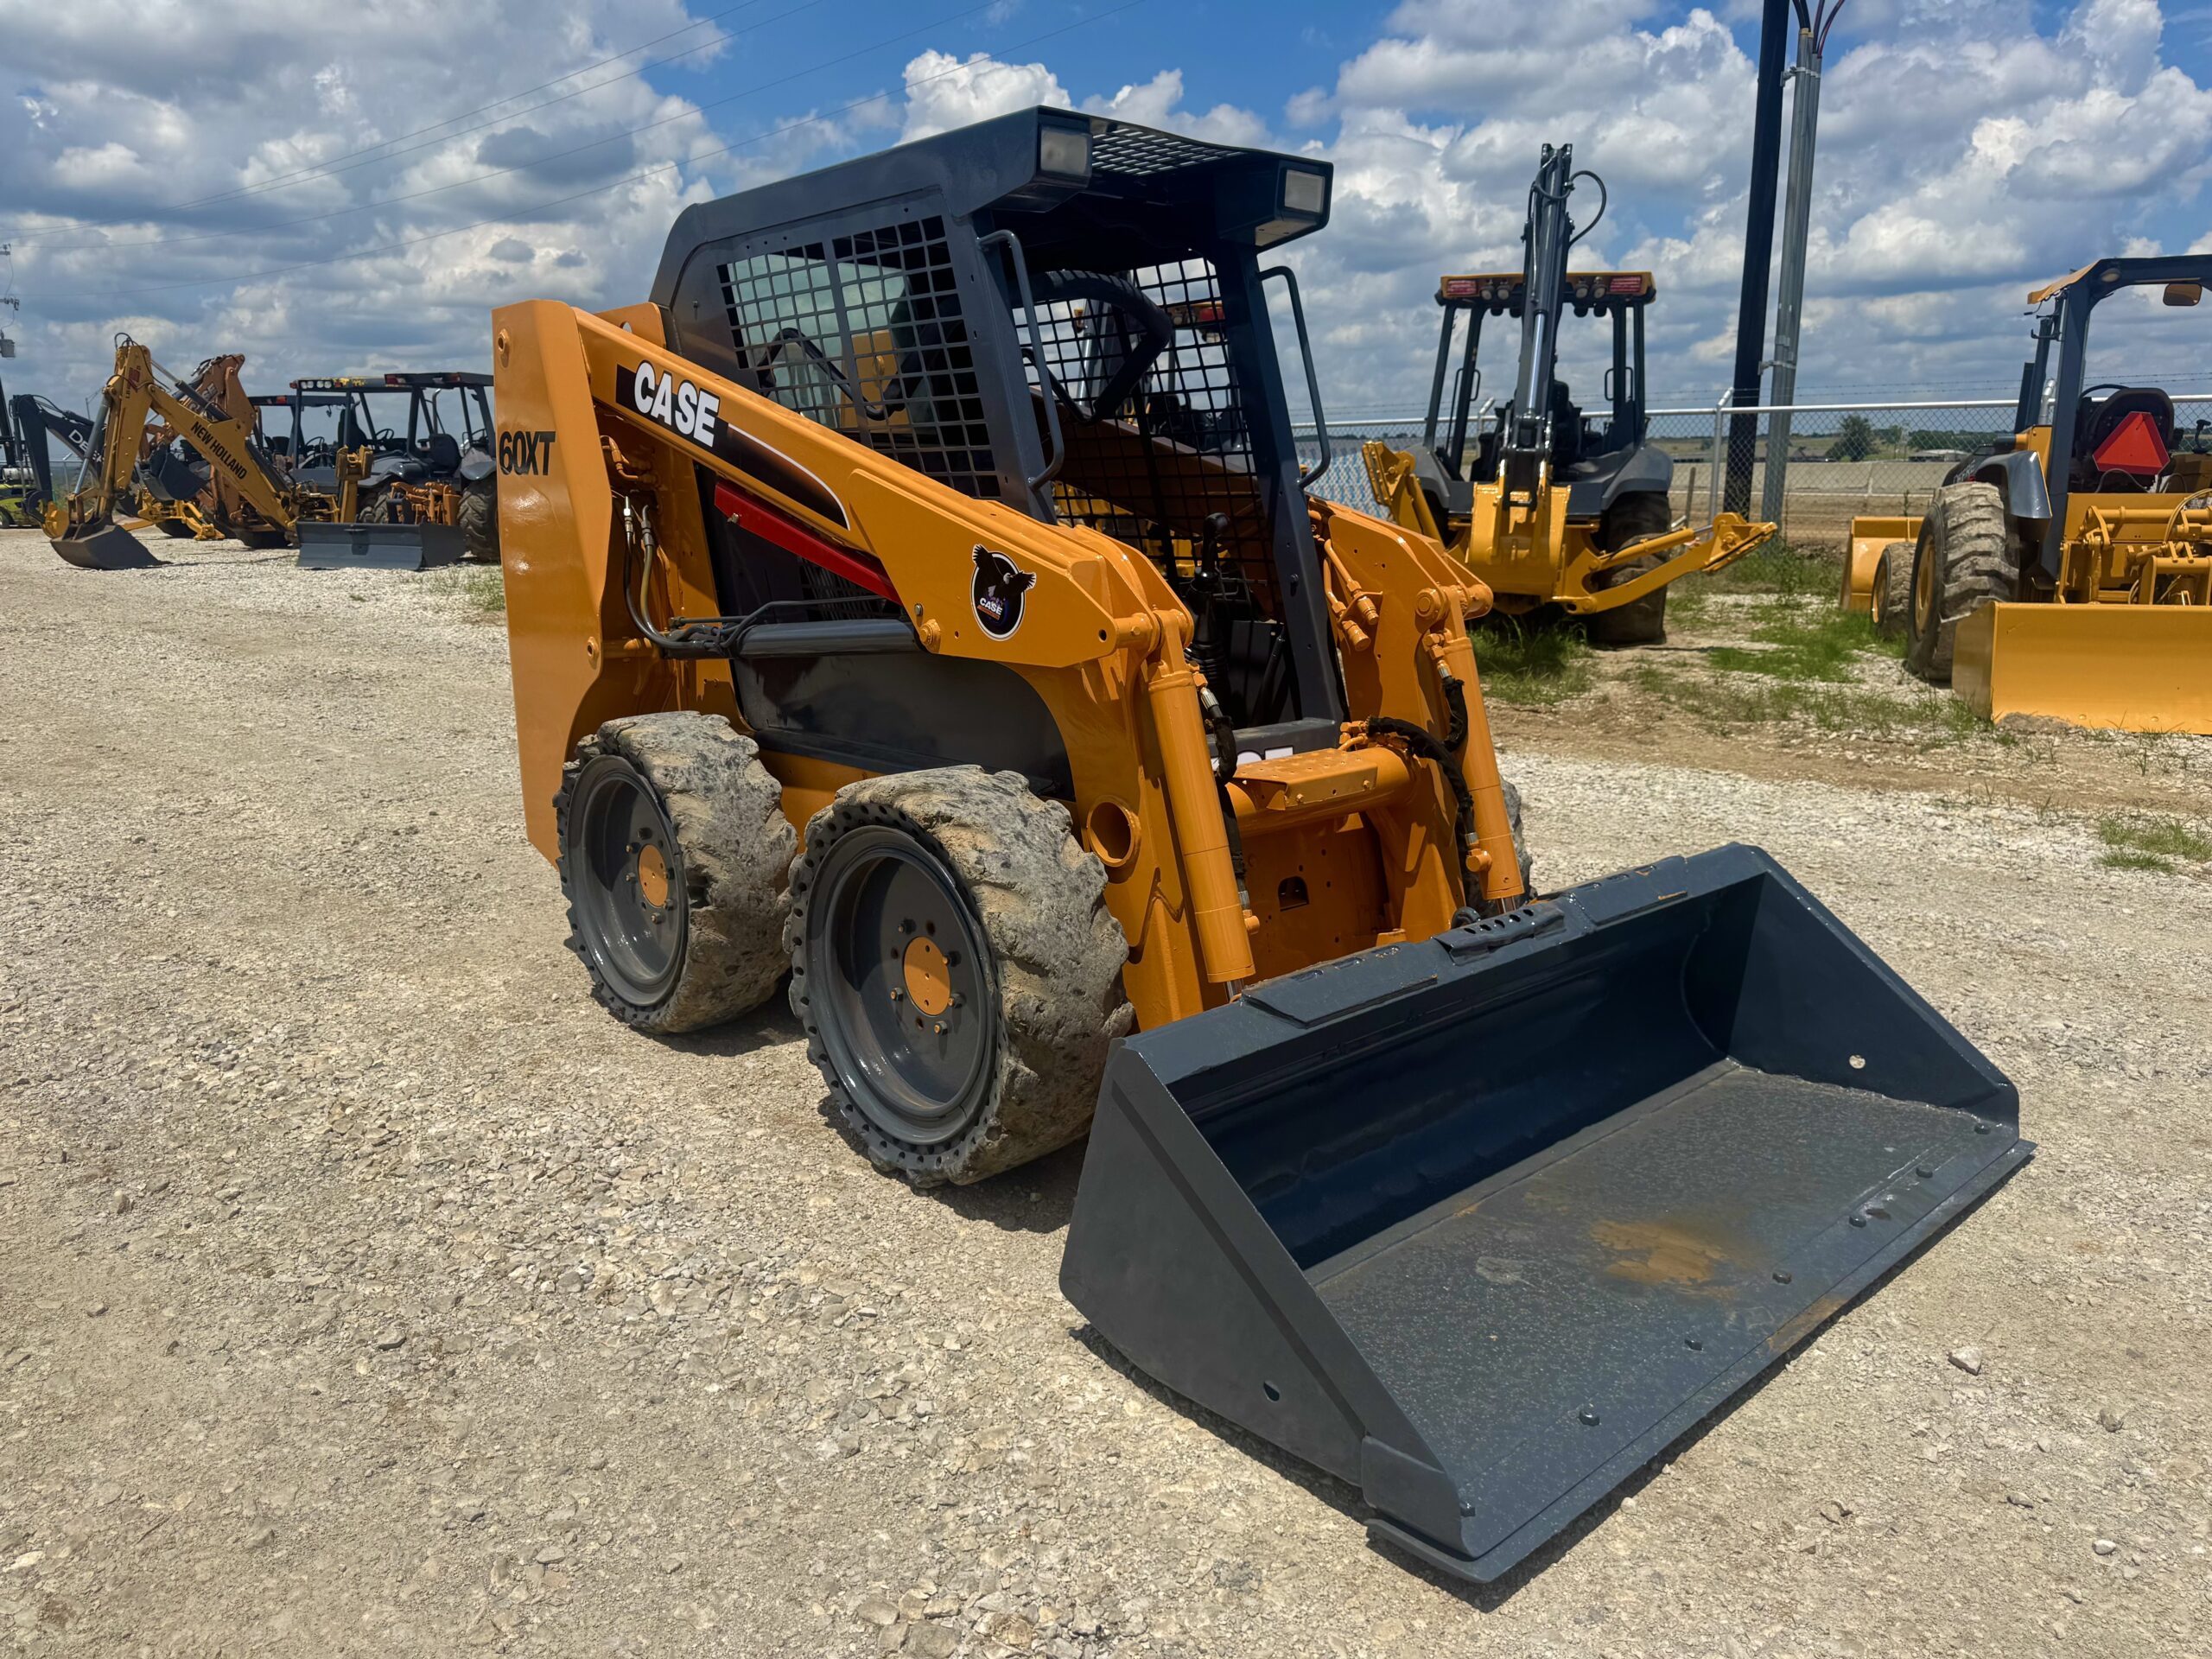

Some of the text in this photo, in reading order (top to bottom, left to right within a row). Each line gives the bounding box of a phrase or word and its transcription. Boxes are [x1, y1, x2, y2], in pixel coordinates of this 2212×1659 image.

[634, 360, 720, 448] CASE
[191, 421, 248, 480] NEW HOLLAND
[499, 430, 556, 476] 60XT
[979, 597, 1002, 615] CASE
